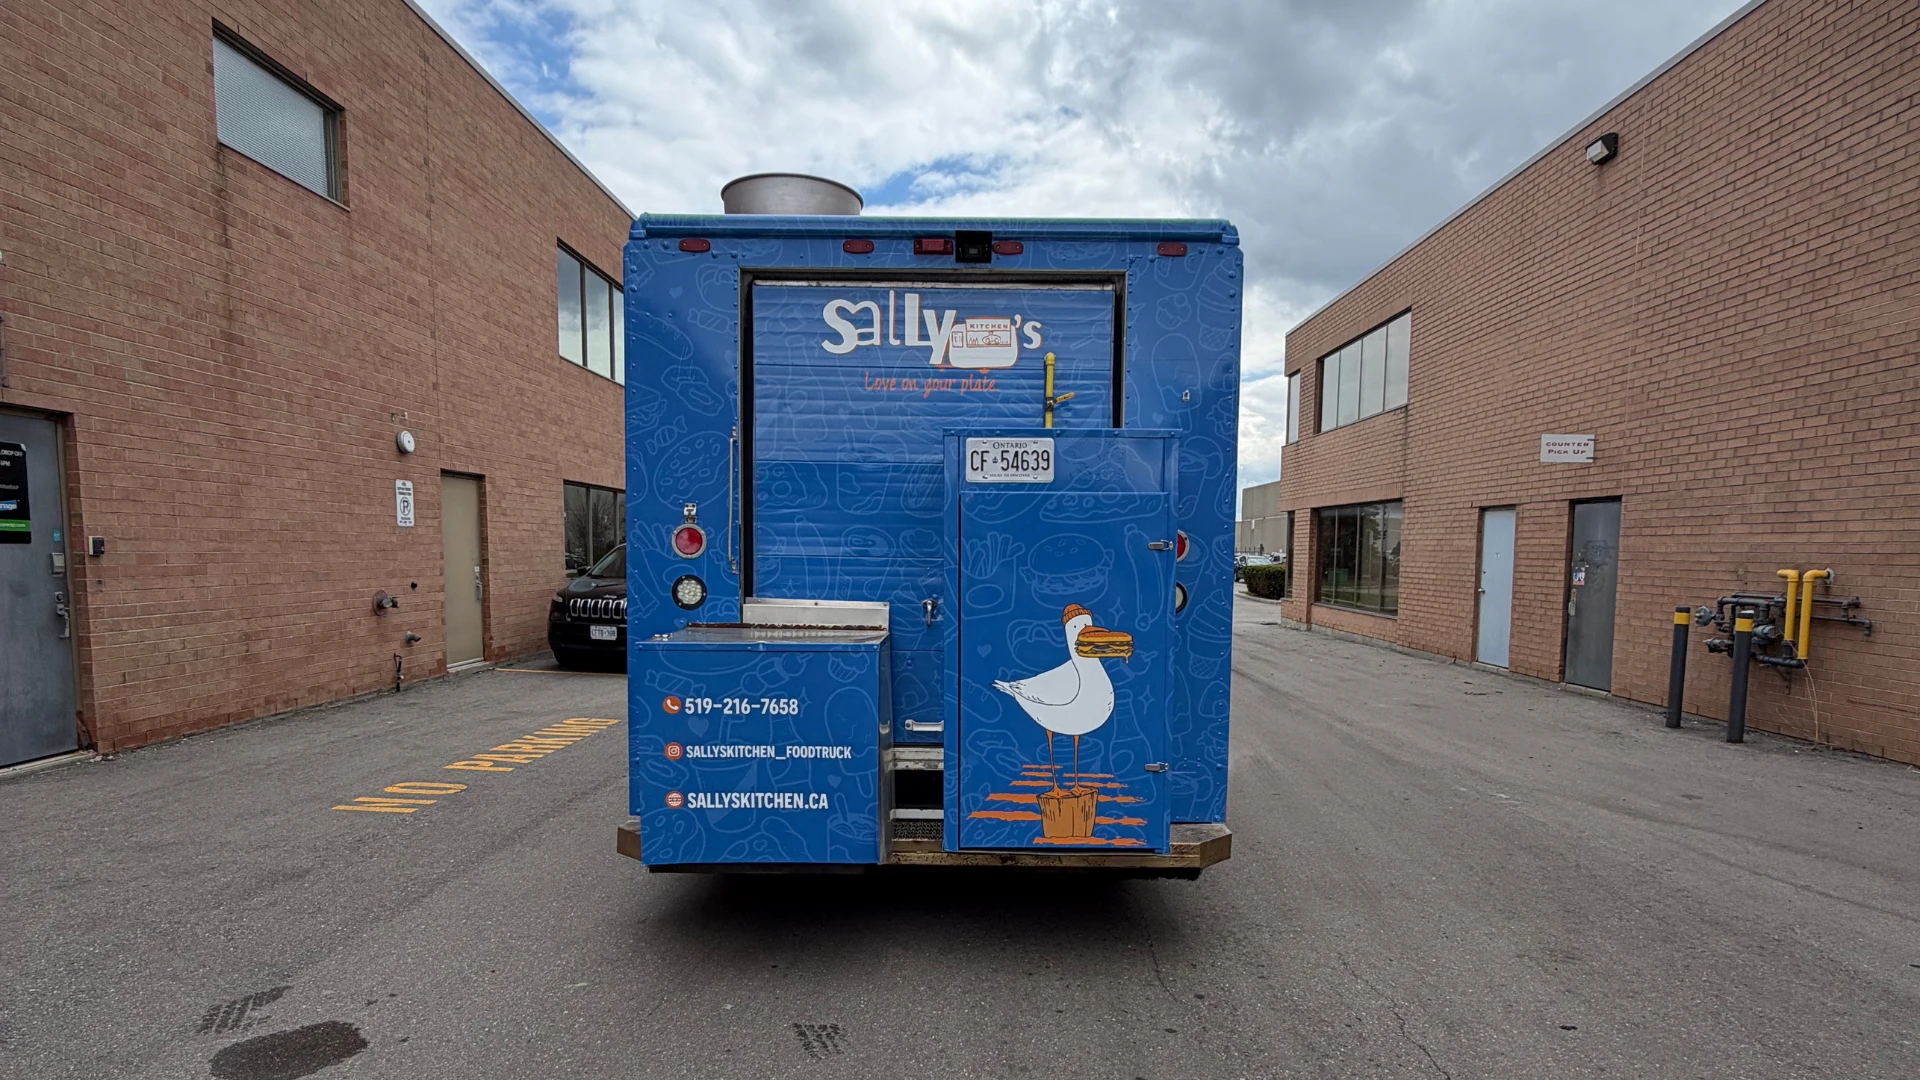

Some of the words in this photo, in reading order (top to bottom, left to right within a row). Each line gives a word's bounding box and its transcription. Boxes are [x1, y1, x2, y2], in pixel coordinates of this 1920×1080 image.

[864, 371, 896, 391] Love
[901, 376, 918, 391] on
[992, 441, 1028, 450] ONTARIO
[970, 450, 990, 472] CF
[1000, 449, 1051, 472] 54639
[684, 698, 799, 715] 519-216-7658
[686, 745, 852, 760] SALLYSKITCHEN_FOODTRUCK
[332, 782, 468, 814] NO
[443, 717, 622, 773] PARKING
[687, 792, 829, 810] SALLYSKITCHEN.CA
